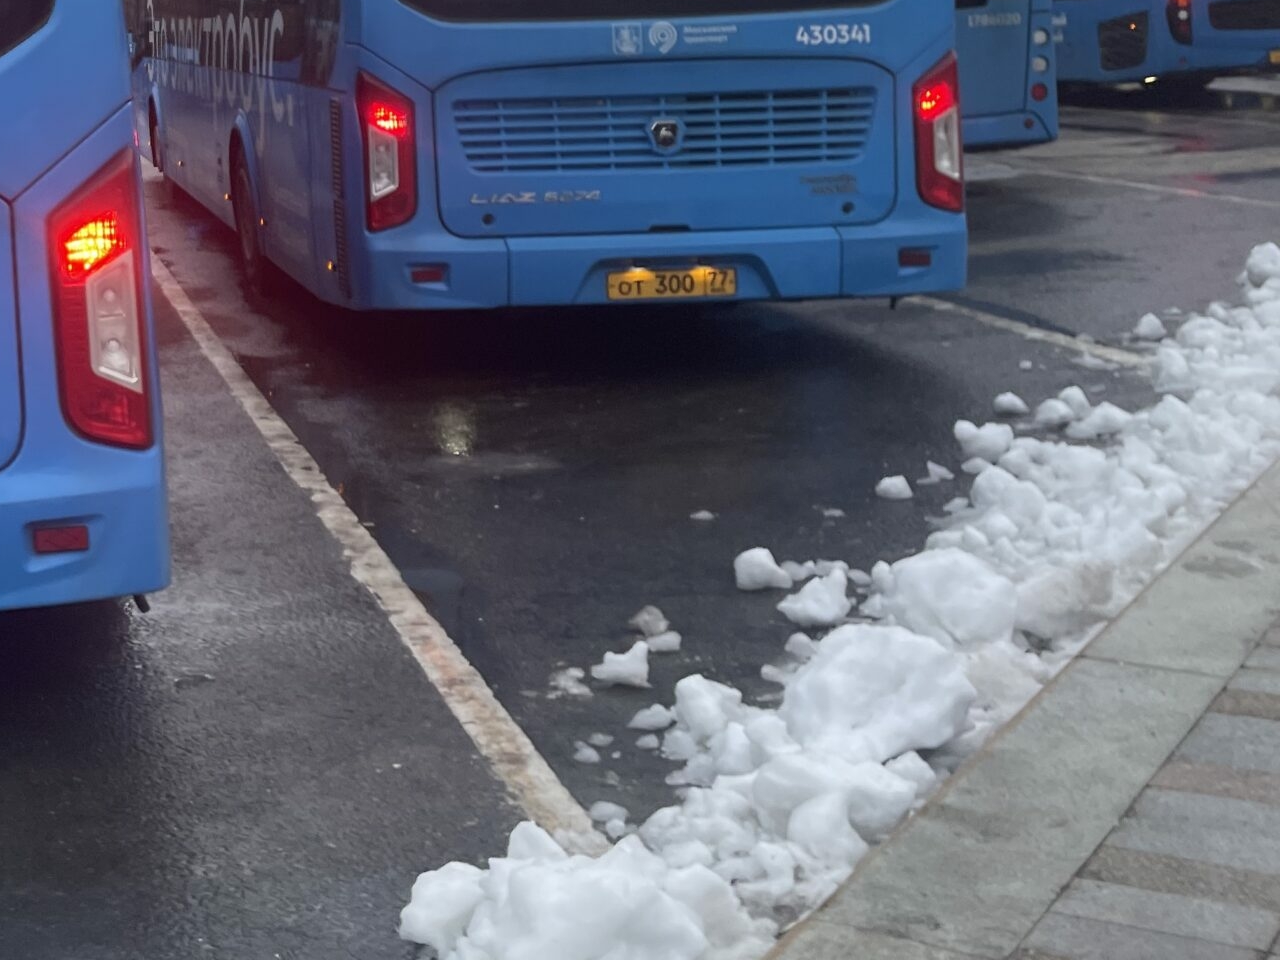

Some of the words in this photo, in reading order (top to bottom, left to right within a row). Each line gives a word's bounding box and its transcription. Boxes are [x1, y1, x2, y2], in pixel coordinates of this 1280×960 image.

[796, 24, 871, 45] 430341
[655, 274, 695, 295] 300
[707, 271, 728, 287] 77
